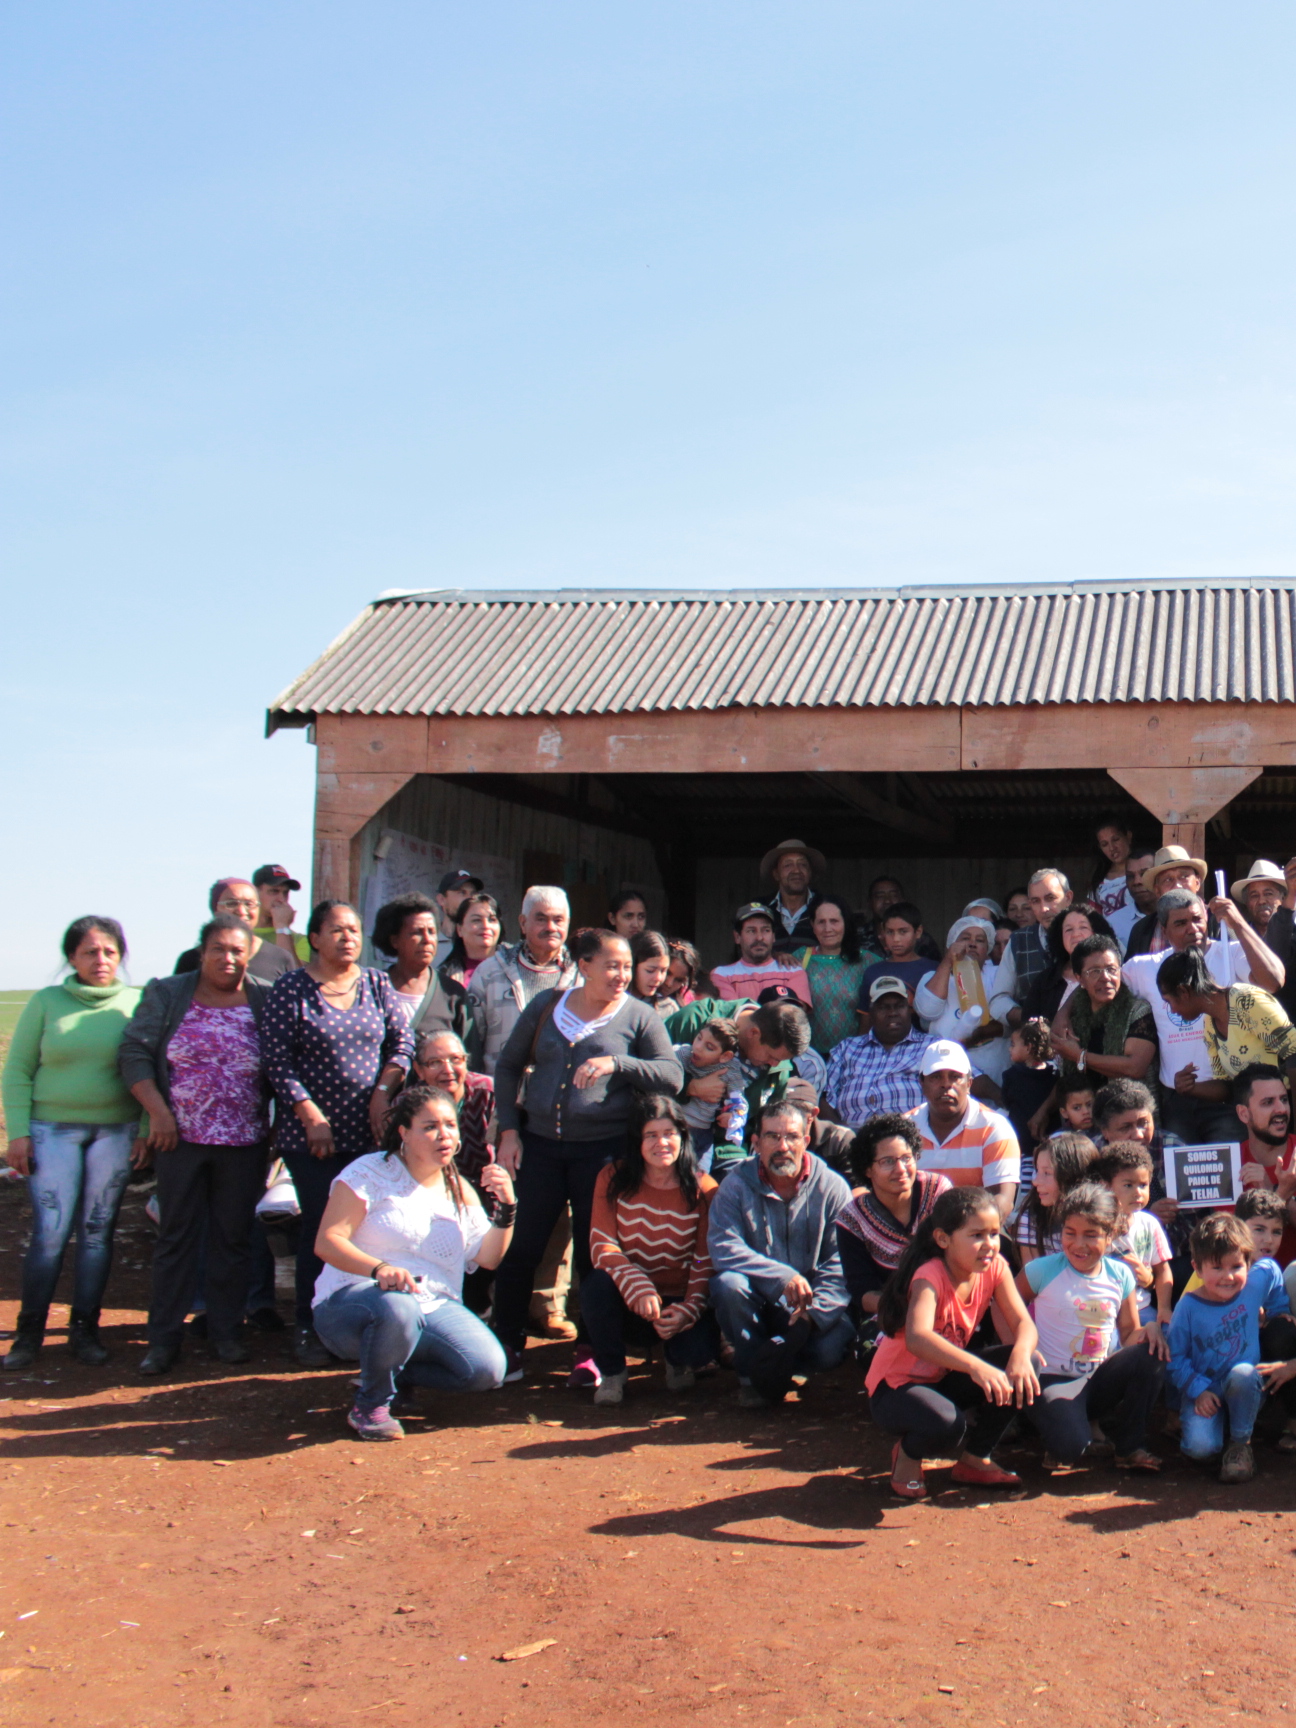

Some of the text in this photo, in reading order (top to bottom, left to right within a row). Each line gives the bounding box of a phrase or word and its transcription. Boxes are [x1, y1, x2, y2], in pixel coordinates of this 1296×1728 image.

[1187, 1150, 1218, 1162] SOMOS
[1183, 1162, 1224, 1175] QUILOMBO
[1187, 1174, 1221, 1186] PAIOL DE
[1190, 1187, 1220, 1200] TELHA
[1221, 1304, 1247, 1327] FOR
